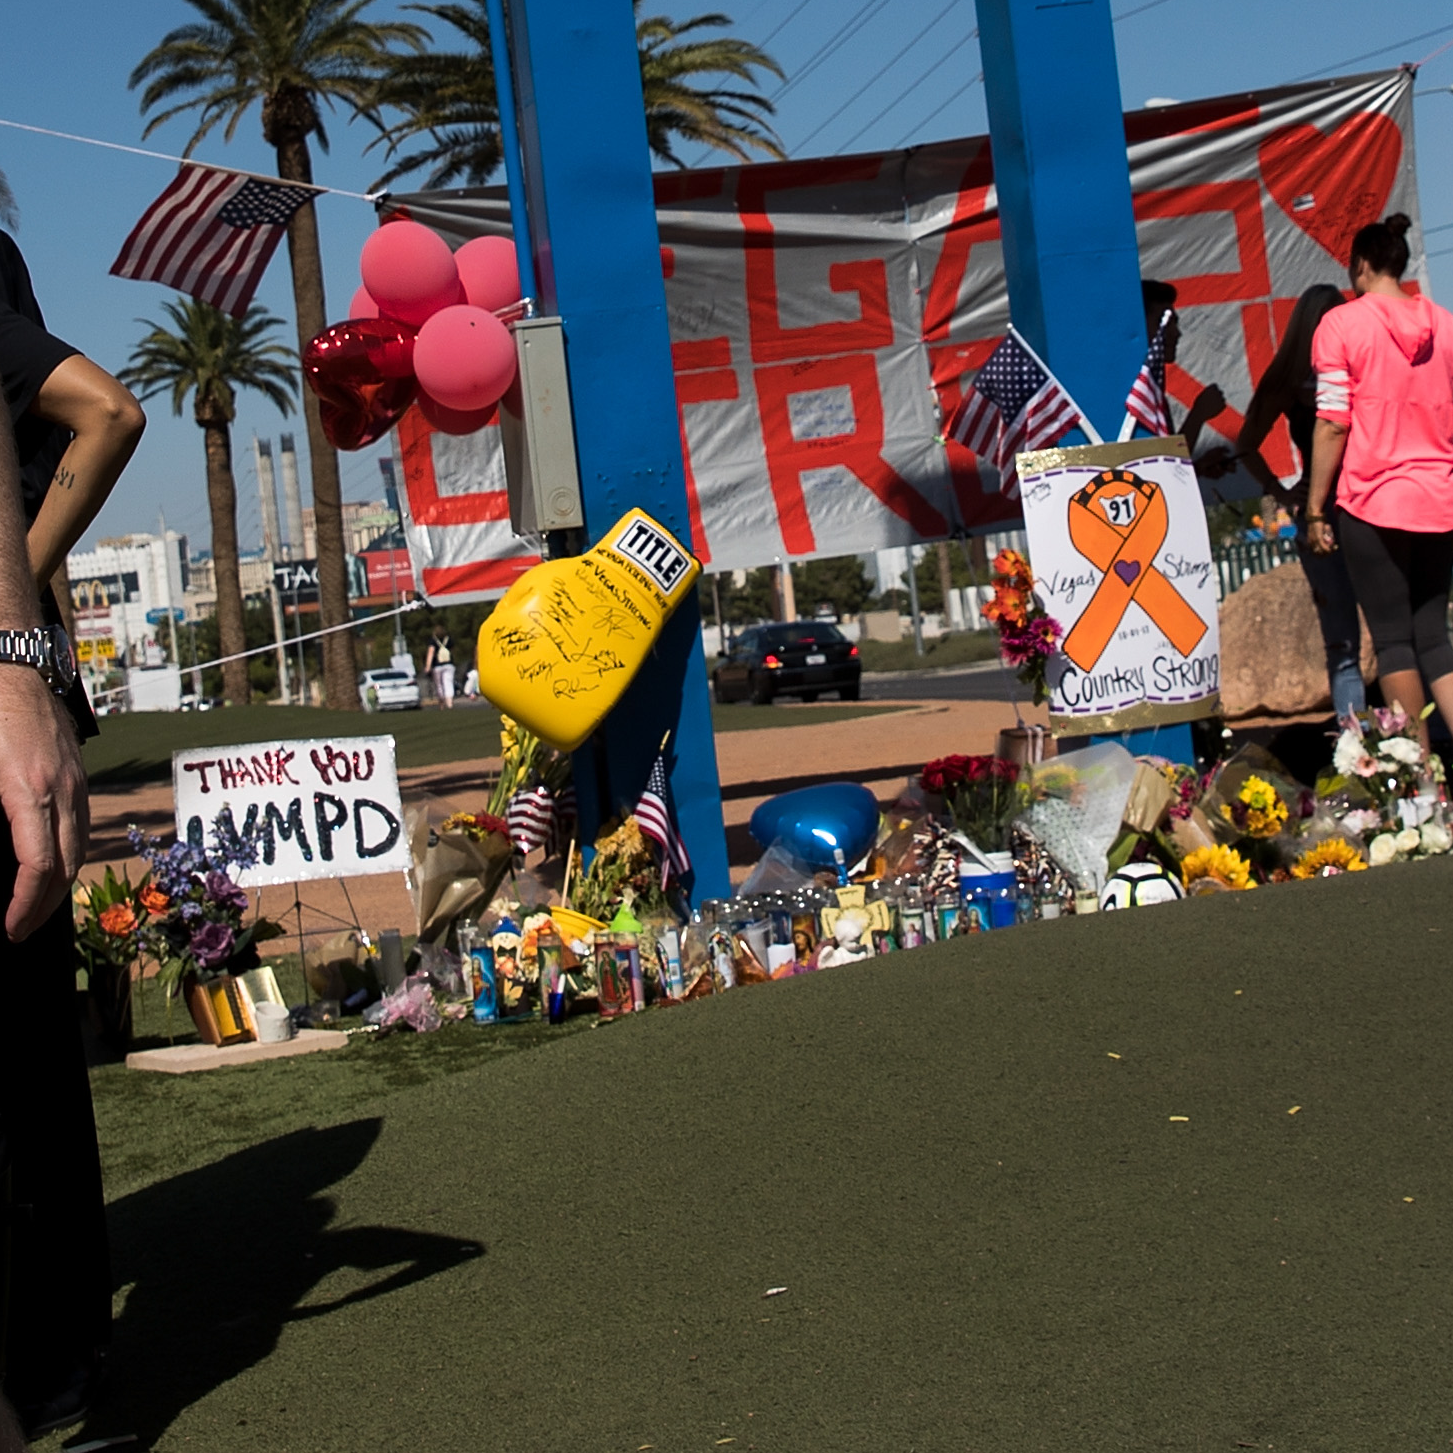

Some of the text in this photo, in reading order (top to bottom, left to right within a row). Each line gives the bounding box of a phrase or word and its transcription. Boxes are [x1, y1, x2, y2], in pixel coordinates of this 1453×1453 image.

[1109, 498, 1132, 522] 91
[628, 524, 684, 584] TITLE
[1038, 552, 1212, 604] Vegas Strong
[1058, 654, 1220, 707] Country Strong
[183, 744, 376, 794] THANK YOU
